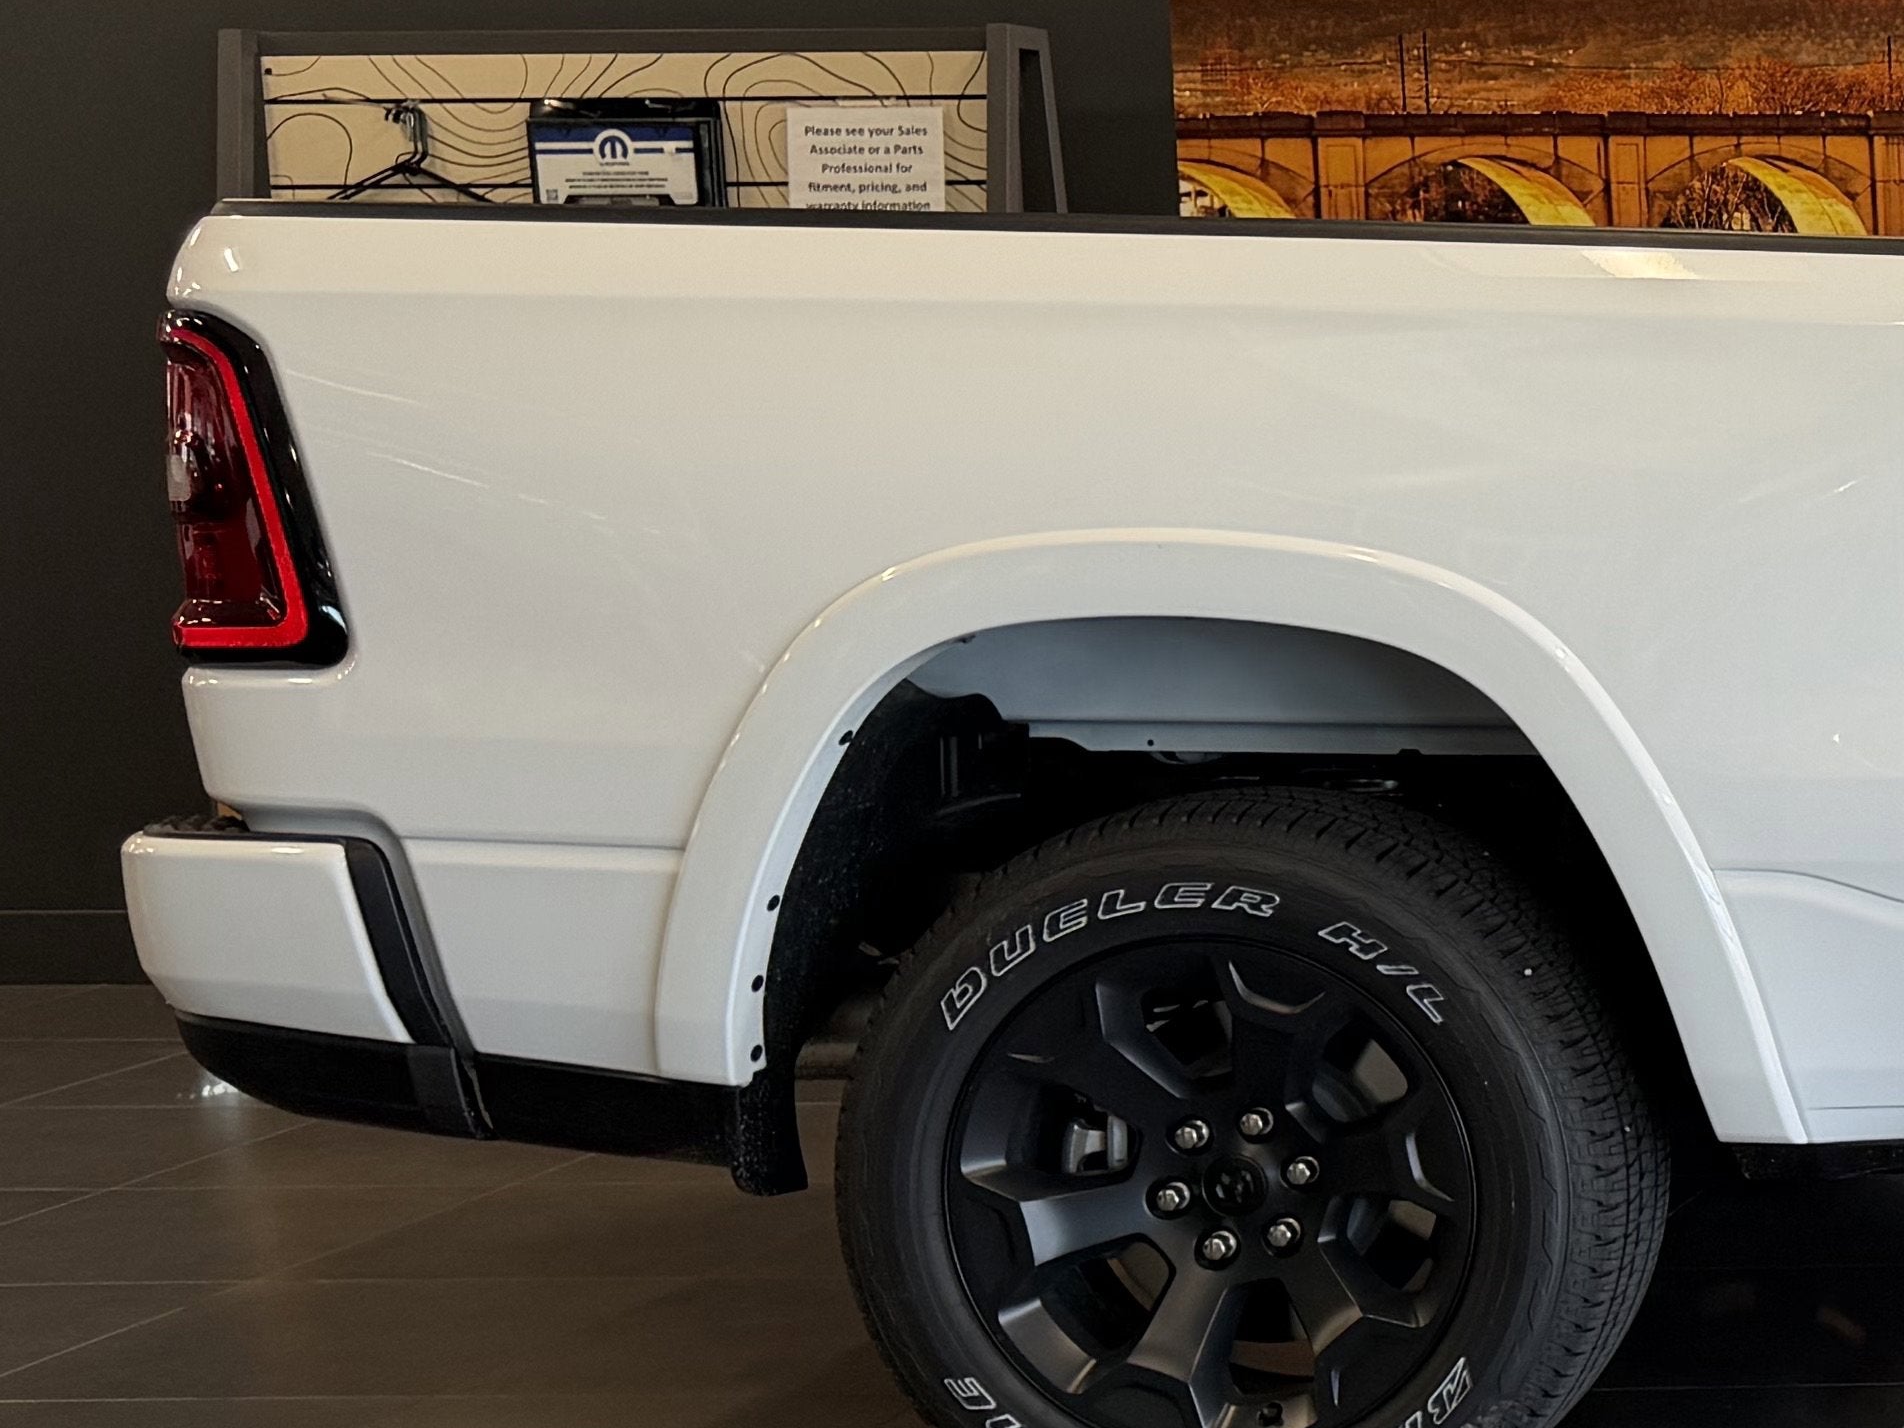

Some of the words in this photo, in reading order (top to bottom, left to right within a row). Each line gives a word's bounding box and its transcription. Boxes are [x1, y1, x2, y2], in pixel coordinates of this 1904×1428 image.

[804, 125, 842, 136] Please
[845, 127, 865, 136] see
[868, 127, 894, 138] your
[897, 125, 928, 136] Sales
[810, 144, 865, 155] Associate
[868, 146, 880, 155] or
[884, 146, 891, 155] a
[894, 144, 924, 155] Parts
[821, 162, 893, 174] Professional
[896, 162, 912, 174] for
[808, 181, 856, 194] fitment,
[858, 181, 902, 195] pricing,
[905, 181, 927, 192] and
[861, 199, 931, 211] information
[942, 880, 1282, 1031] DUELER
[1319, 920, 1451, 1025] H/L
